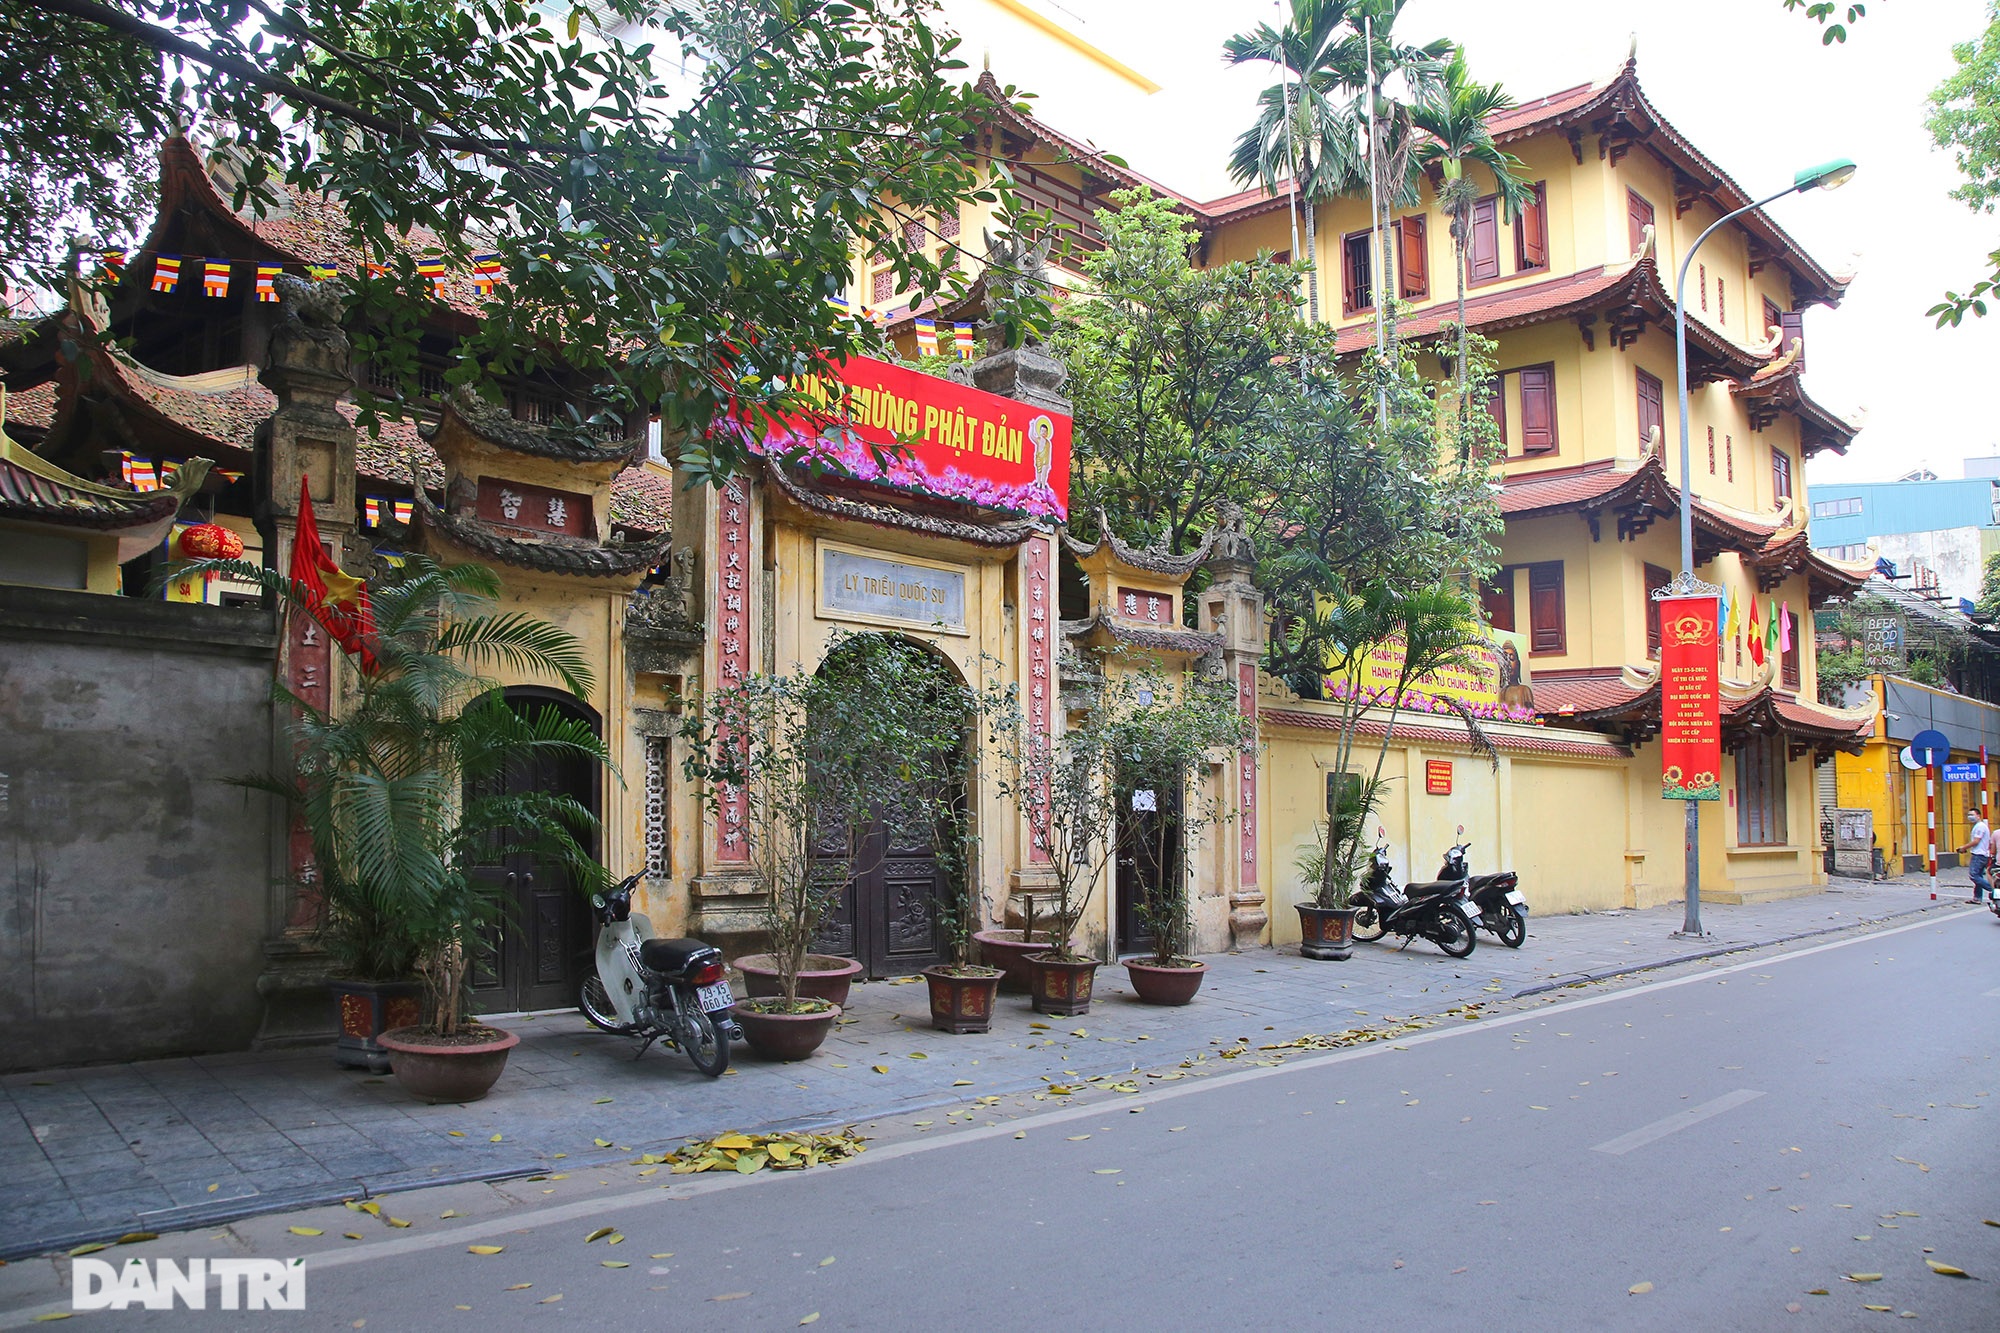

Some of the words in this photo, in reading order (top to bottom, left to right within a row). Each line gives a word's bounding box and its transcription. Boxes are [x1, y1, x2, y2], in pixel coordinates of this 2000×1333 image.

[850, 383, 918, 436] MỪNG
[924, 404, 977, 457] PHẬT
[982, 414, 1024, 464] ĐẢN
[180, 583, 191, 596] SA
[844, 571, 860, 592] LÝ
[899, 580, 928, 603] QUỐC
[1868, 618, 1897, 629] BEER
[1867, 631, 1897, 641] FOOD
[1867, 642, 1896, 652] CAFE
[1947, 771, 1977, 780] HUYỆN
[702, 984, 727, 1000] 29-X5
